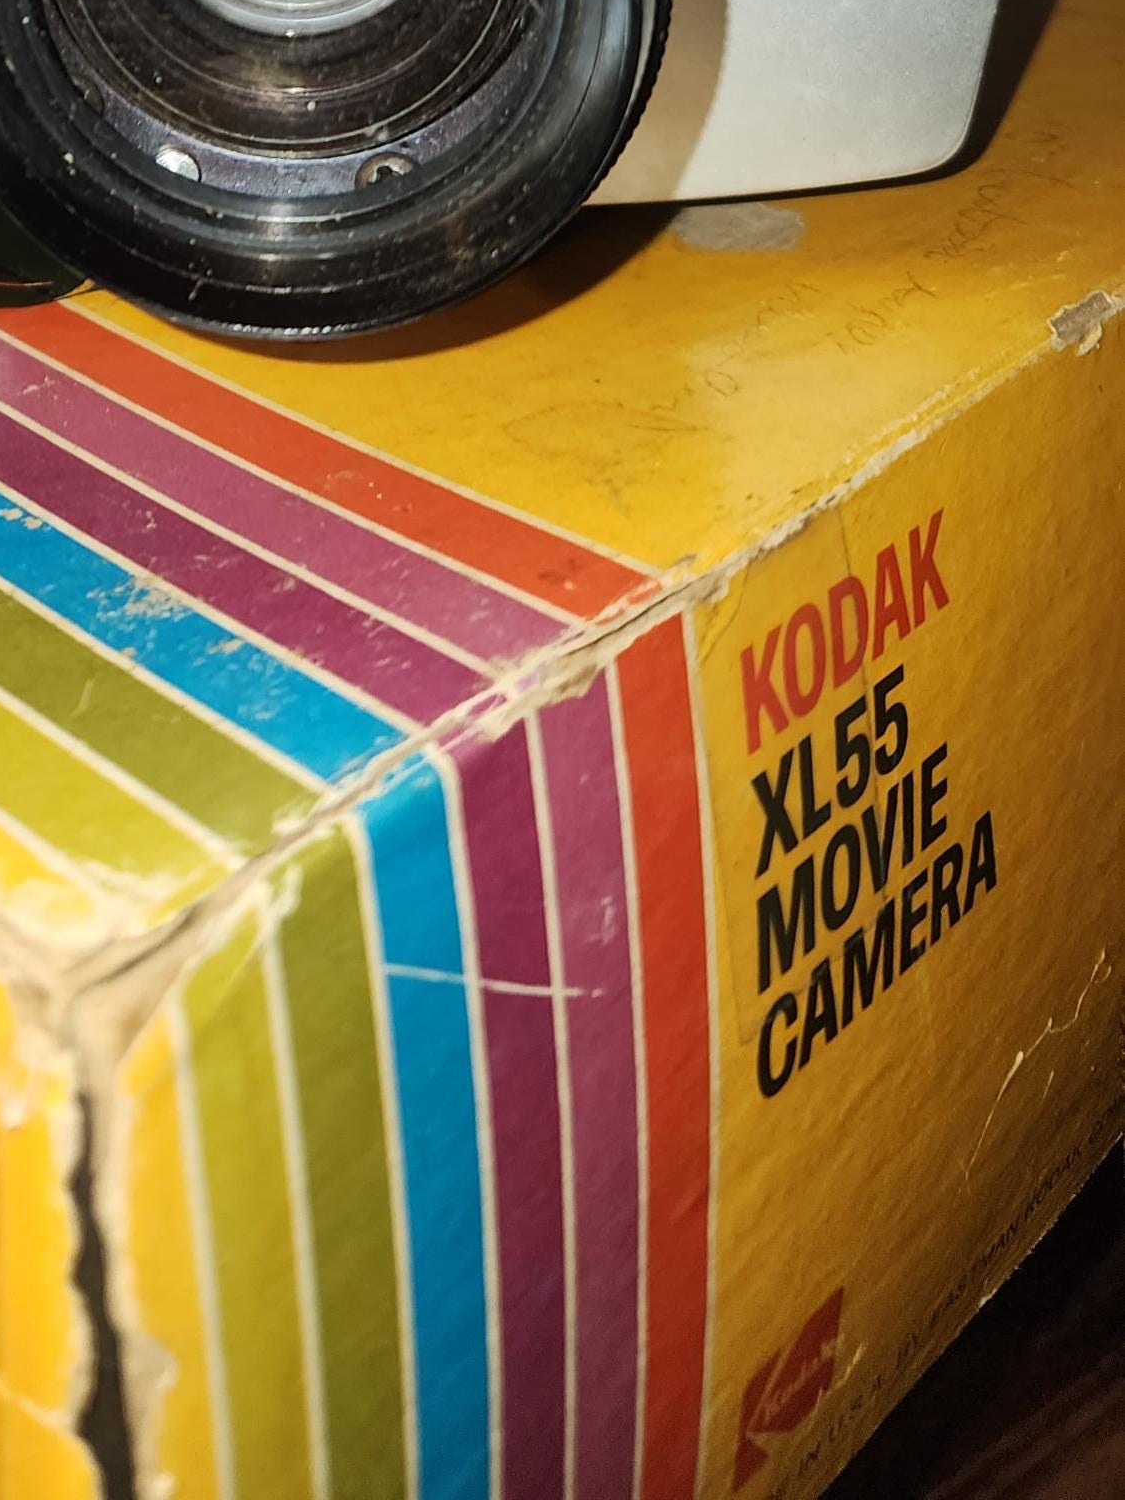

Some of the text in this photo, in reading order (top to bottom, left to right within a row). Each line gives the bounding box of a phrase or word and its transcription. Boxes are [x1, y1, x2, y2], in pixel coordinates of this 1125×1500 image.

[740, 506, 949, 756] KODAK
[751, 664, 909, 879] XL55
[757, 742, 948, 996] MOVIE
[756, 810, 998, 1099] CAMERA
